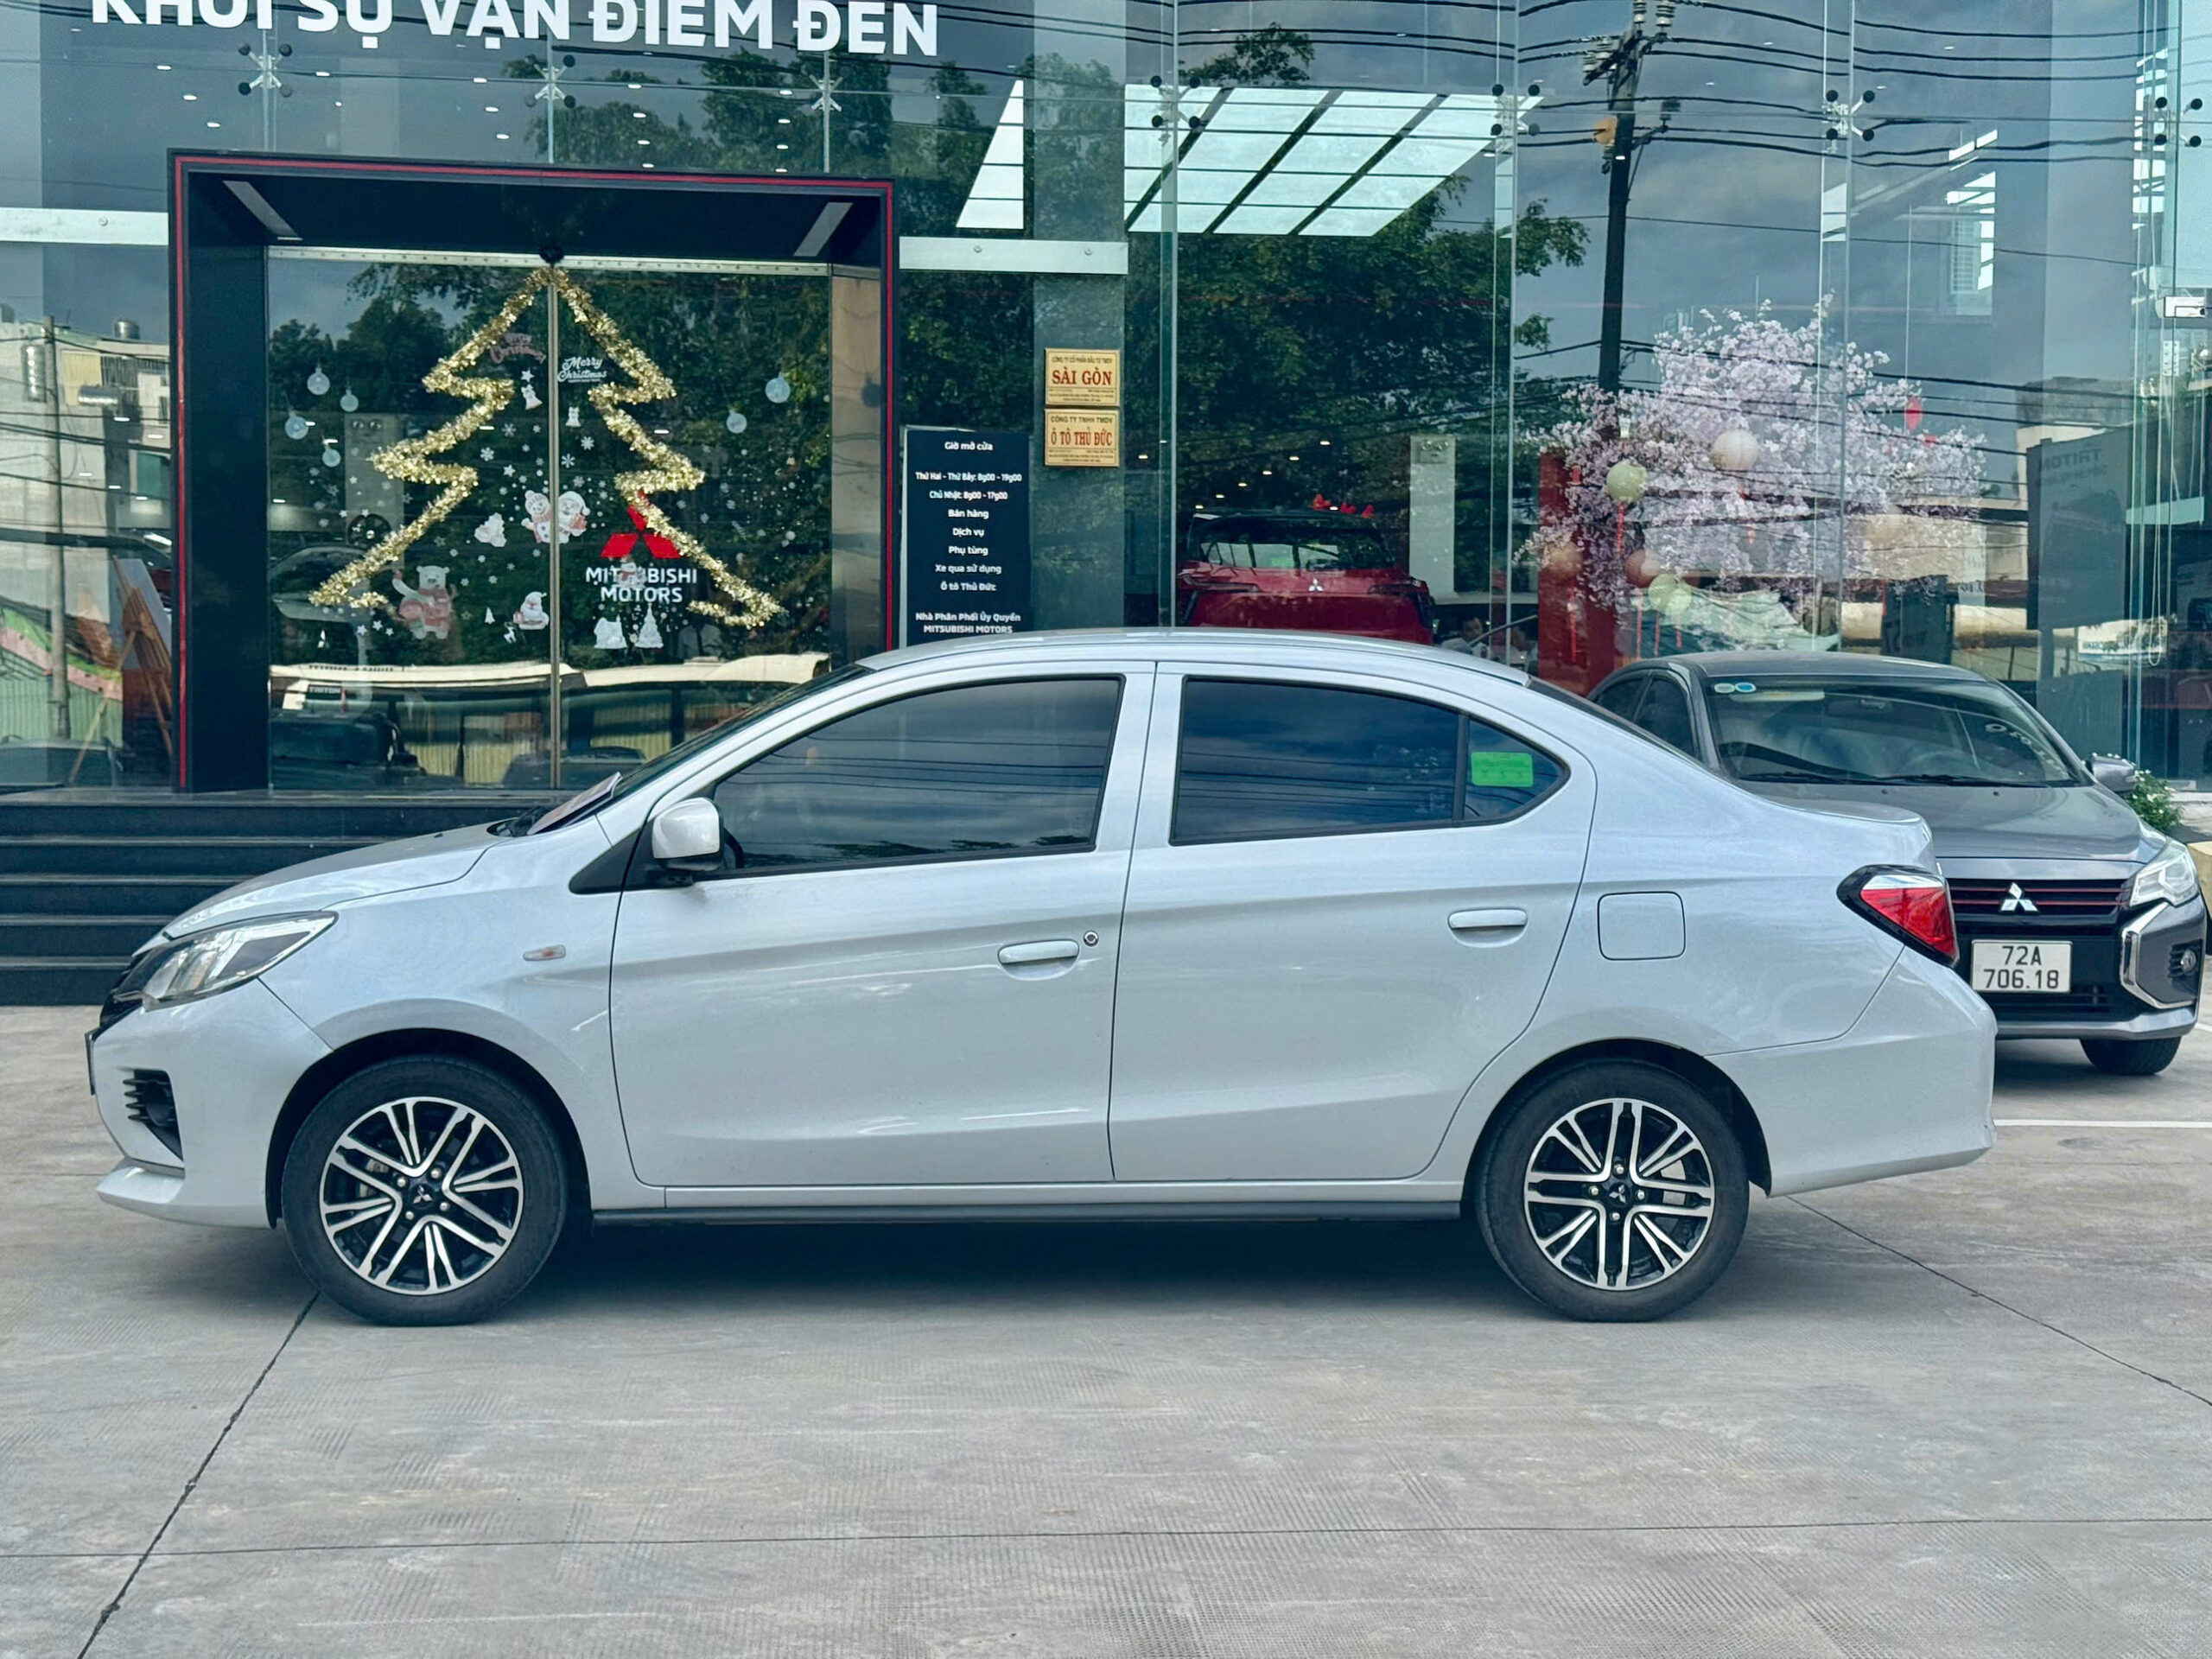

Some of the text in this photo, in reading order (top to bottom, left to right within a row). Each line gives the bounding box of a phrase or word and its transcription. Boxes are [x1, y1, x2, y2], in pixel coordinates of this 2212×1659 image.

[562, 356, 603, 371] Merry
[557, 369, 607, 383] Christmas
[1052, 366, 1113, 385] SÀI GÒN
[1051, 426, 1113, 446] Ô TÔ THỦ ĐỨC
[944, 441, 994, 451] Giờ mở cửa
[915, 472, 929, 480] Thứ
[930, 472, 942, 480] Hai
[948, 472, 961, 480] Thứ
[977, 474, 995, 483] 8g00
[1001, 474, 1022, 483] 19g00
[929, 490, 943, 499] Chủ
[963, 492, 982, 501] 8g00
[988, 492, 1007, 501] 17g00
[948, 509, 988, 519] Bán hàng
[952, 527, 972, 537] Dịch
[948, 546, 988, 556] Phụ tùng
[586, 567, 697, 583] MITBISHI
[935, 564, 946, 573] Xe
[966, 563, 979, 573] sử
[979, 564, 1002, 575] dụng
[940, 581, 997, 592] Ô tô Thủ Đức
[601, 588, 683, 603] MOTORS
[915, 611, 1021, 623] Nhà Phân Phối Ủy Quyền
[923, 625, 1014, 633] MITSUBISHI MOTORS
[2002, 946, 2042, 966] 72A
[1984, 969, 2059, 989] 706.18
